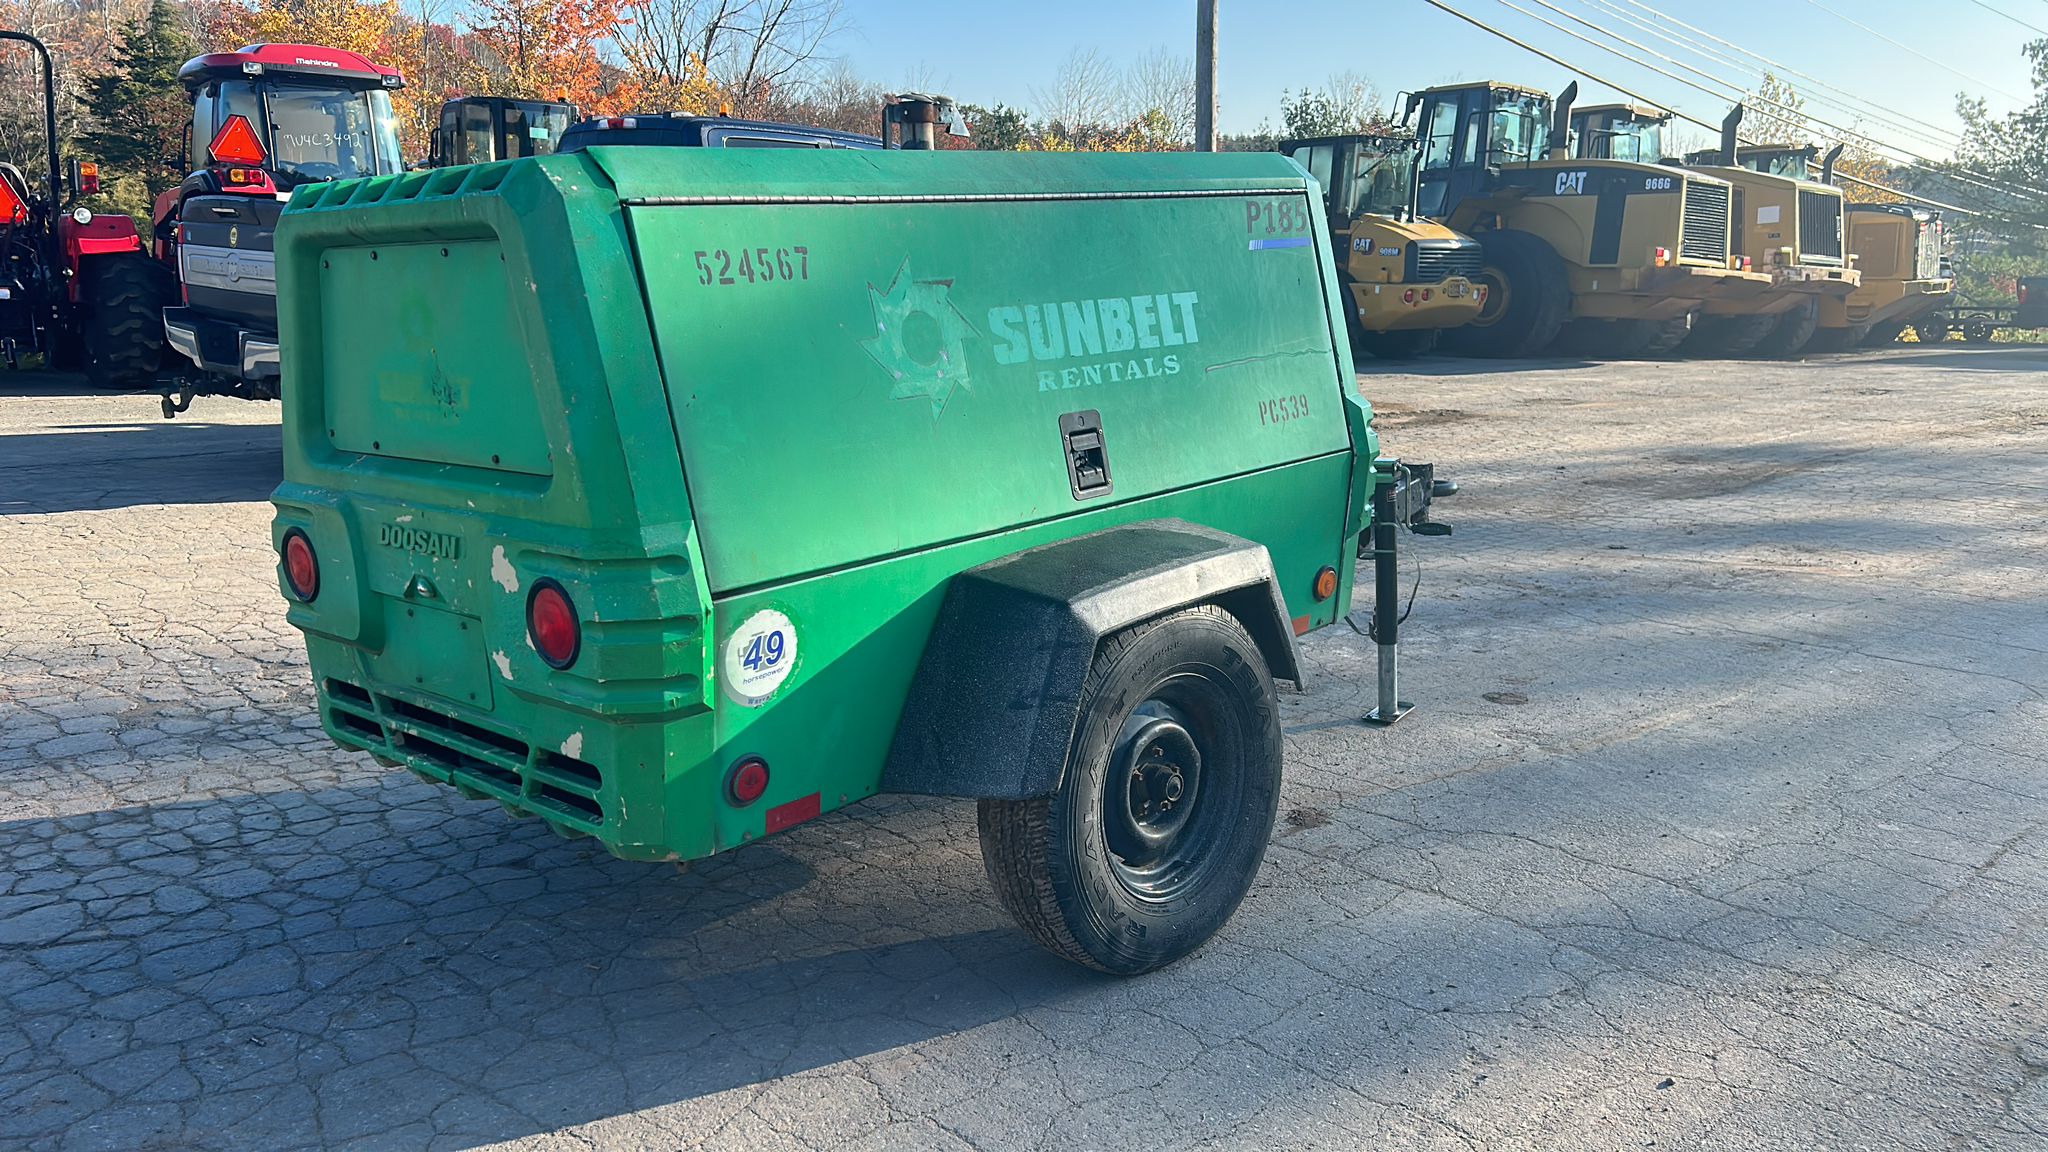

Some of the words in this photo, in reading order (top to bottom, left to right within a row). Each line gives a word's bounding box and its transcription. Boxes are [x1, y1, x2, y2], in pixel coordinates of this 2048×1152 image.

[1555, 171, 1587, 195] CAT
[1645, 178, 1671, 190] 966G
[1247, 200, 1307, 233] P185
[1353, 238, 1372, 252] CAT
[694, 246, 808, 286] 524567
[987, 291, 1199, 365] SUNBELT
[1038, 354, 1181, 392] RENTALS
[1259, 394, 1309, 425] PC539
[379, 523, 459, 560] DOOSAN
[743, 630, 785, 671] 49
[743, 667, 785, 685] horsepower
